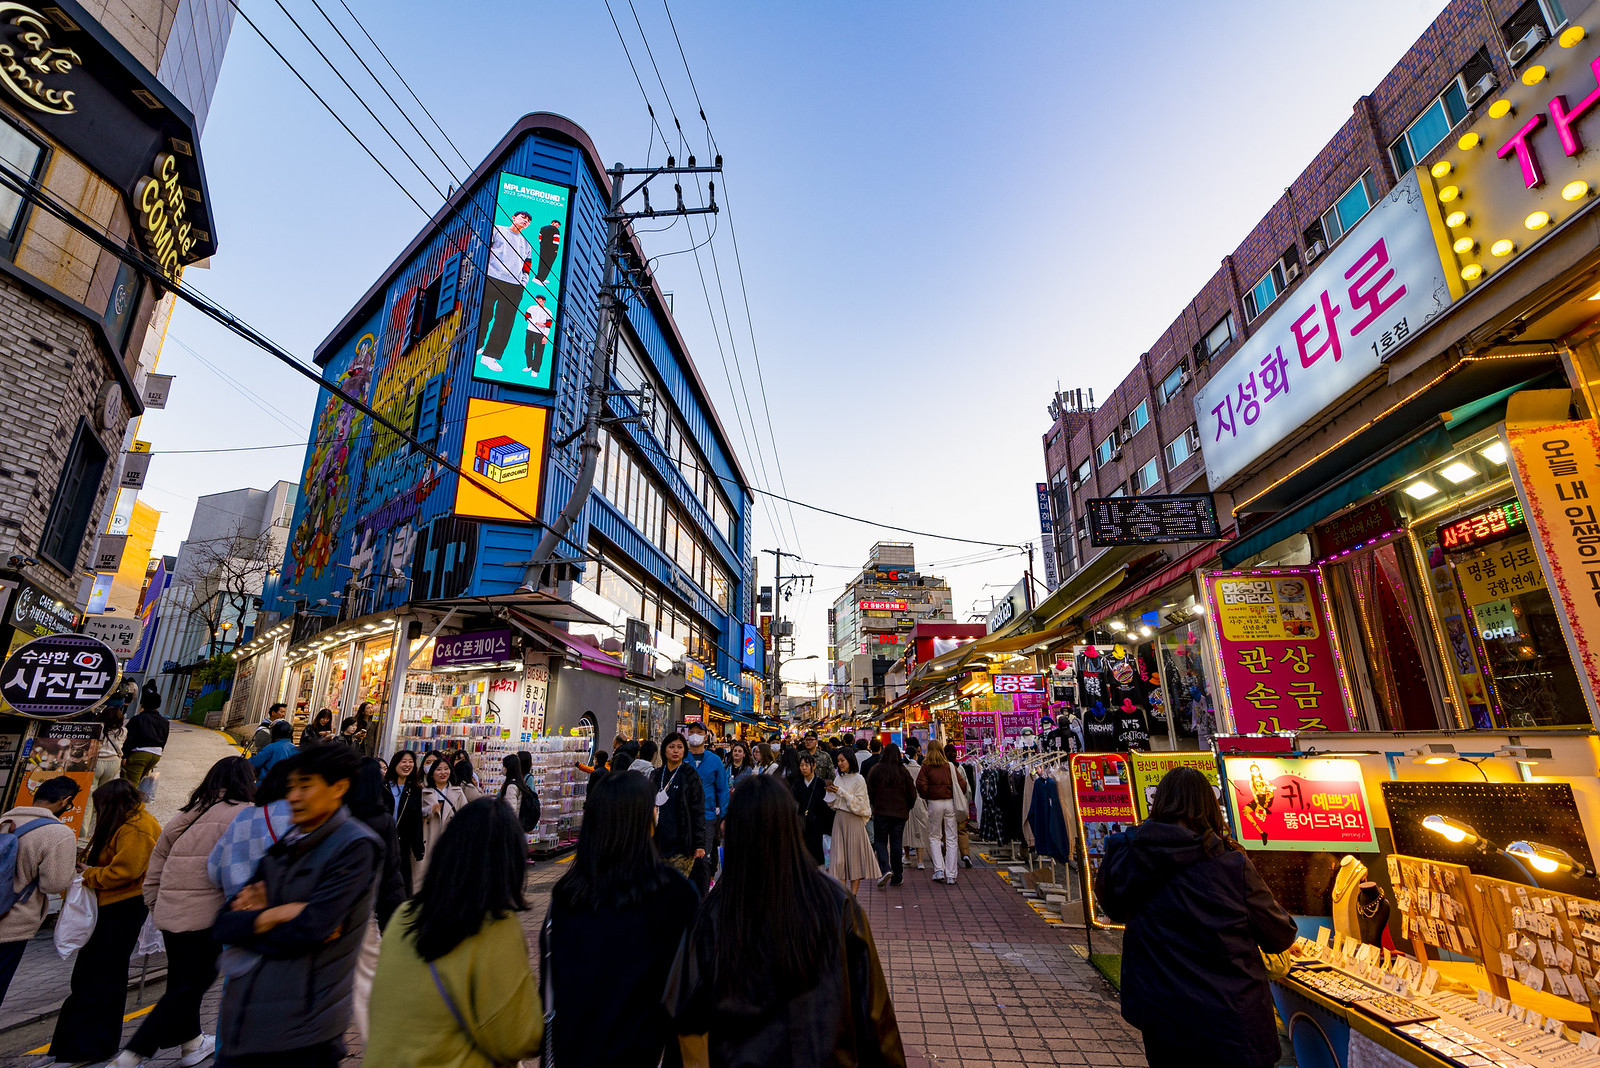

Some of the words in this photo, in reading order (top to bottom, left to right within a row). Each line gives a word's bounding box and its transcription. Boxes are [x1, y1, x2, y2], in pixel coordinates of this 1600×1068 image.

[162, 154, 186, 227] CAFE
[503, 182, 561, 202] MPLAYGROUND
[516, 192, 536, 201] SPRING
[536, 197, 564, 207] LOOKBOOK
[1210, 344, 1291, 443] 지성화
[1291, 236, 1408, 371] 타로
[1369, 316, 1411, 358] 1호점
[1542, 439, 1579, 477] 오늘
[127, 471, 141, 479] LIZE
[502, 468, 527, 479] GROUND
[1555, 480, 1589, 501] 내
[1467, 557, 1498, 582] 명품
[1500, 547, 1535, 571] 타로
[1221, 581, 1273, 594] 화성인
[39, 594, 54, 610] CAFE
[1223, 593, 1275, 605] 바이러스
[1486, 619, 1505, 630] 2023
[879, 634, 898, 644] DVD
[21, 649, 70, 666] 수상한
[1238, 646, 1316, 674] 관상
[3, 666, 111, 699] 사진관
[1244, 682, 1324, 710] 손금
[523, 700, 544, 717] 케이스
[963, 715, 994, 725] 사주타로
[49, 732, 91, 740] Welcome
[1137, 760, 1159, 772] 당신의
[1312, 793, 1361, 812] 예쁘게
[1284, 812, 1365, 830] 뚫어드려요!
